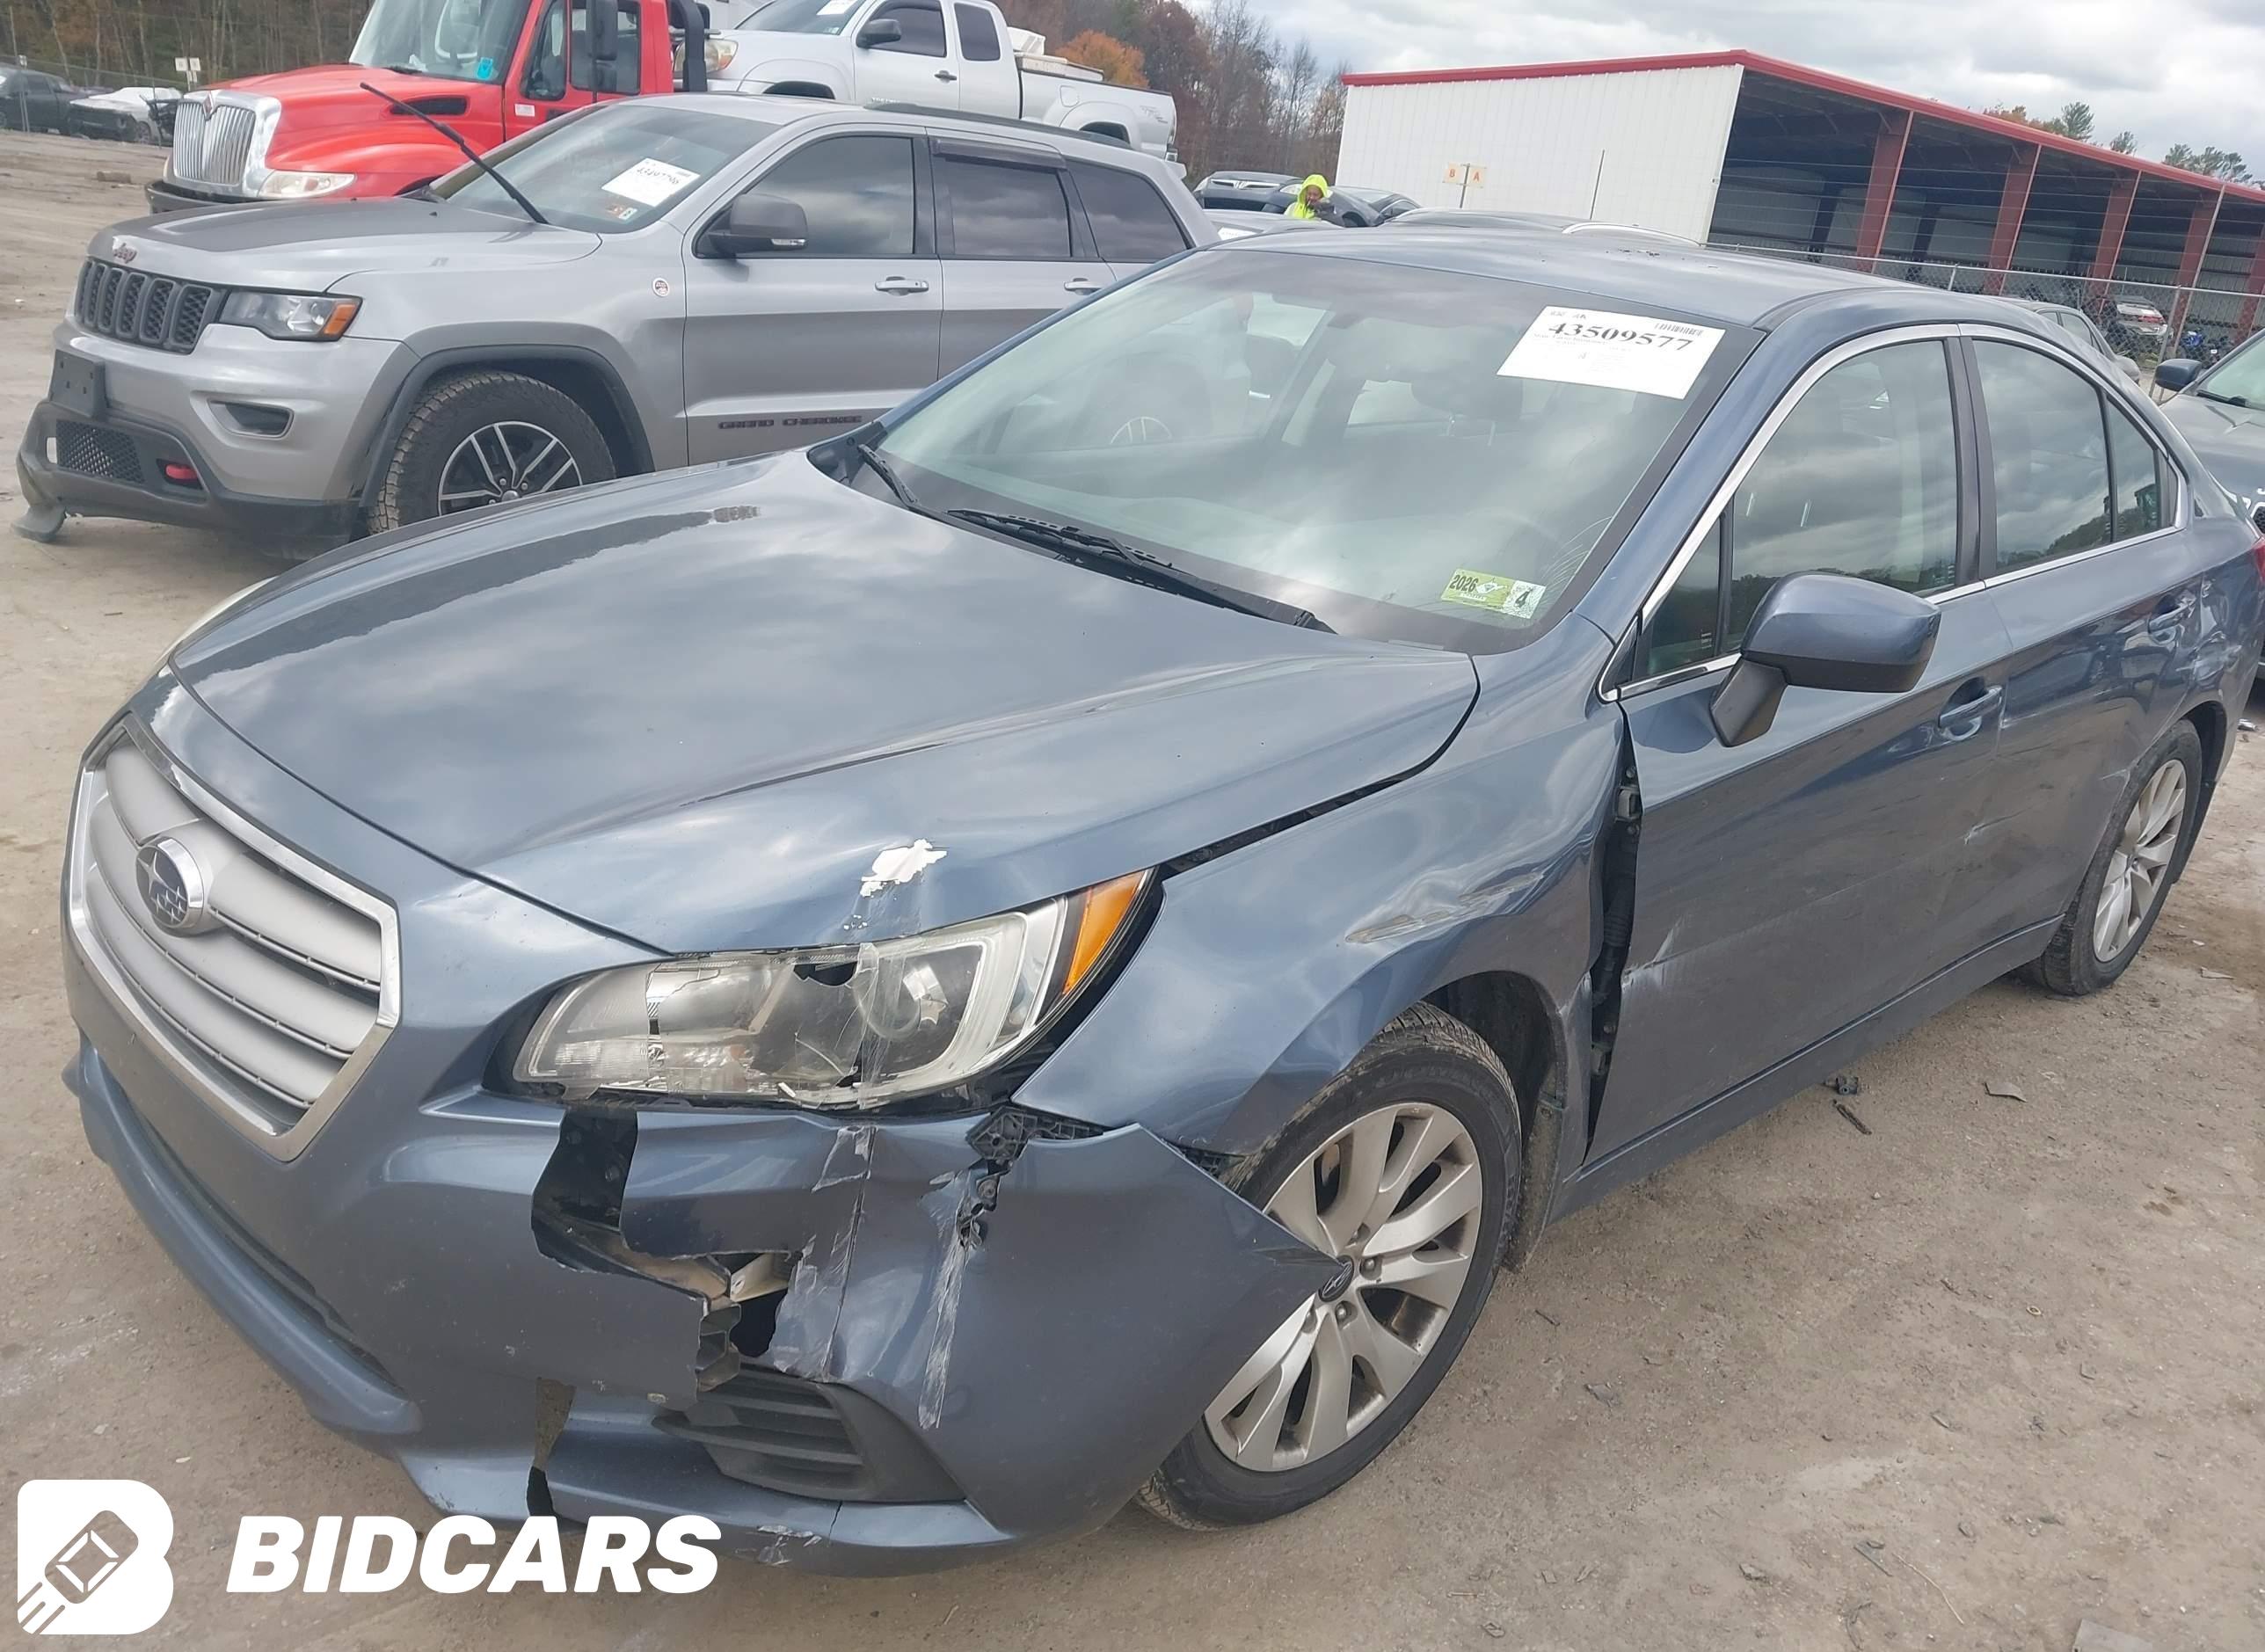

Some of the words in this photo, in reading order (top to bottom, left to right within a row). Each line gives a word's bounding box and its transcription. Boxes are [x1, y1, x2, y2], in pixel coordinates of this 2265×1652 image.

[1548, 322, 1694, 351] 43509577
[1449, 574, 1479, 593] 2026
[1515, 586, 1533, 608] 4
